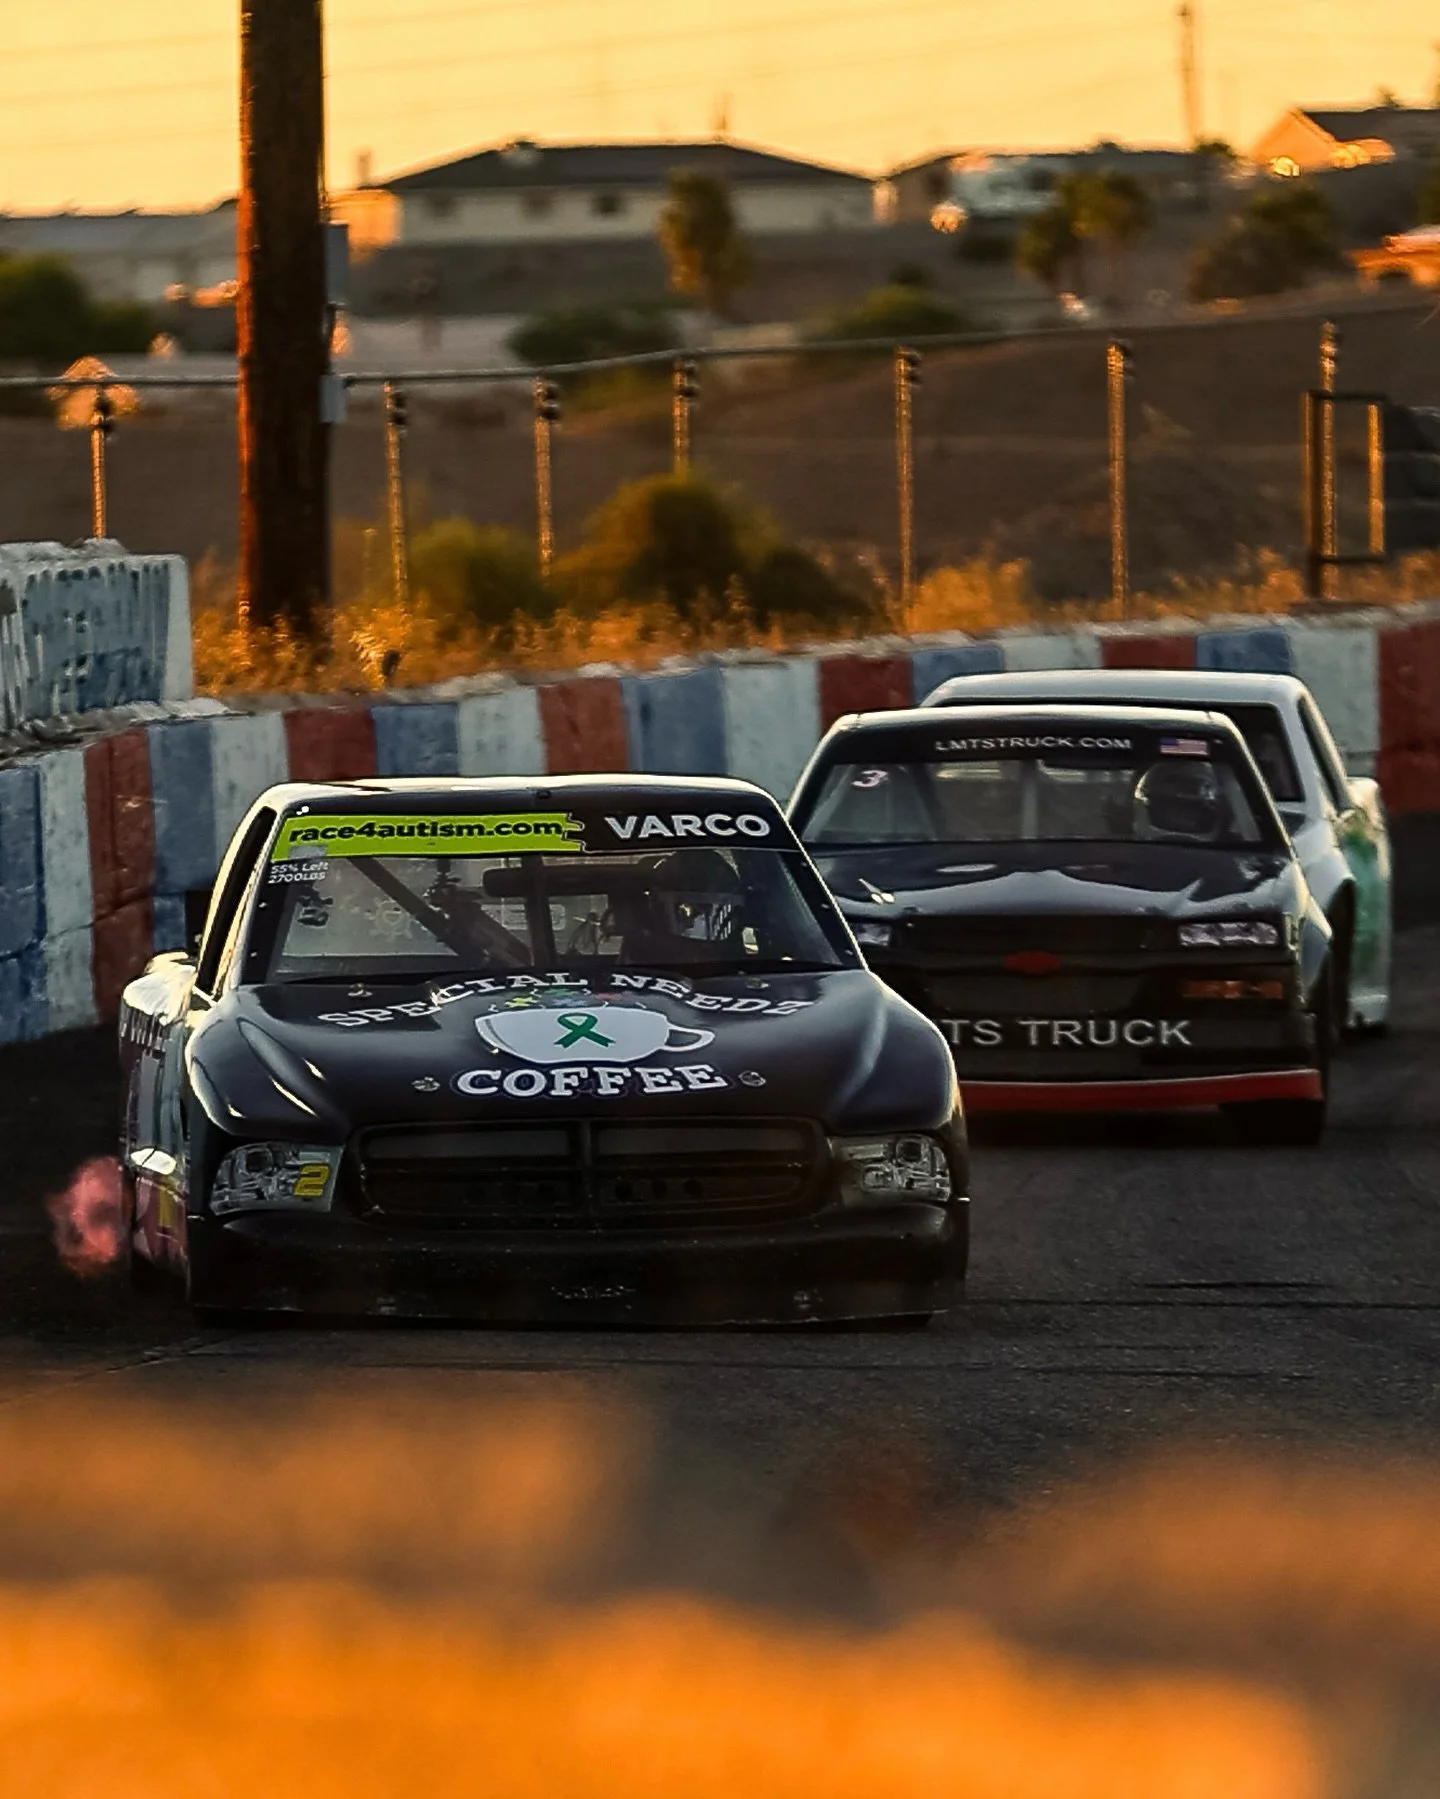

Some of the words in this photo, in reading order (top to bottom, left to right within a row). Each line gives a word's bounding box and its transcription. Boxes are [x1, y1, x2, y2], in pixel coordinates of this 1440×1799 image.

[935, 736, 1132, 751] LMTSTRUCK.COM
[851, 769, 888, 788] 3
[288, 820, 563, 843] race4autism.com
[604, 813, 770, 839] VARCO
[317, 972, 589, 1026] SPECIAL
[610, 973, 816, 1016] NEEDZ
[935, 1019, 1003, 1045] TS
[1017, 1019, 1192, 1045] TRUCK
[457, 1063, 728, 1097] COFFEE
[294, 1164, 329, 1197] 2
